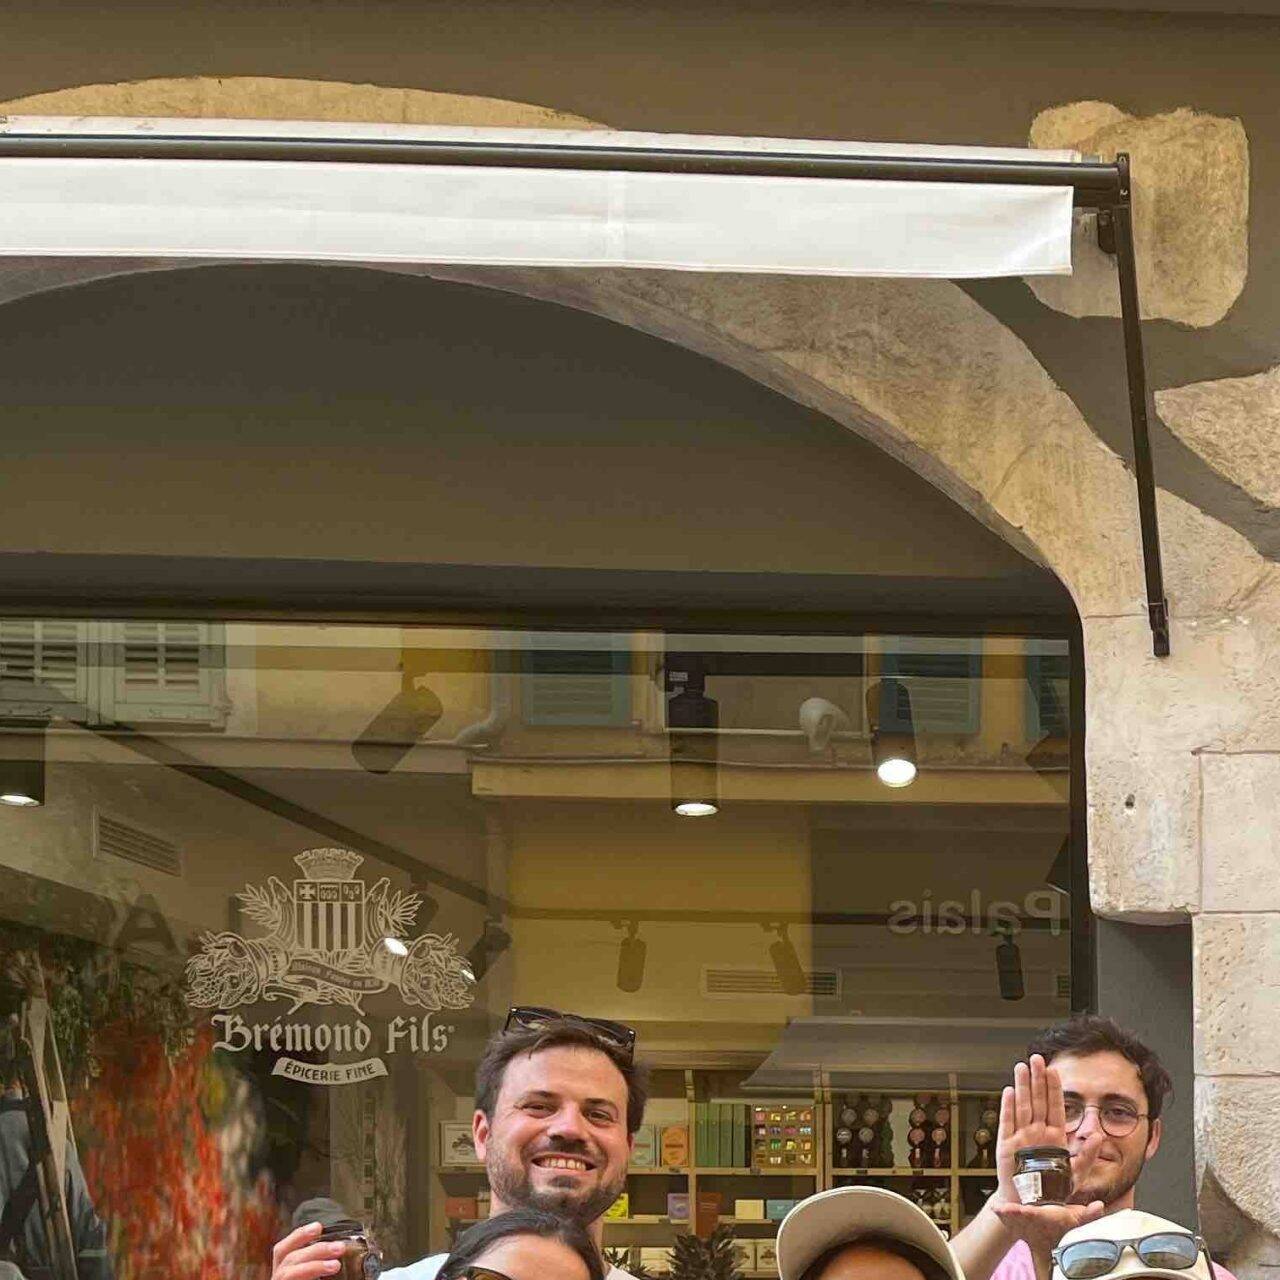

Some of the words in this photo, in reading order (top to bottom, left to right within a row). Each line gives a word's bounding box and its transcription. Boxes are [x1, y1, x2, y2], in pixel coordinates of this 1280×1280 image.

[211, 1013, 372, 1052] Brémond
[284, 1063, 342, 1083] ÉPICERIE
[346, 1062, 375, 1080] FINE
